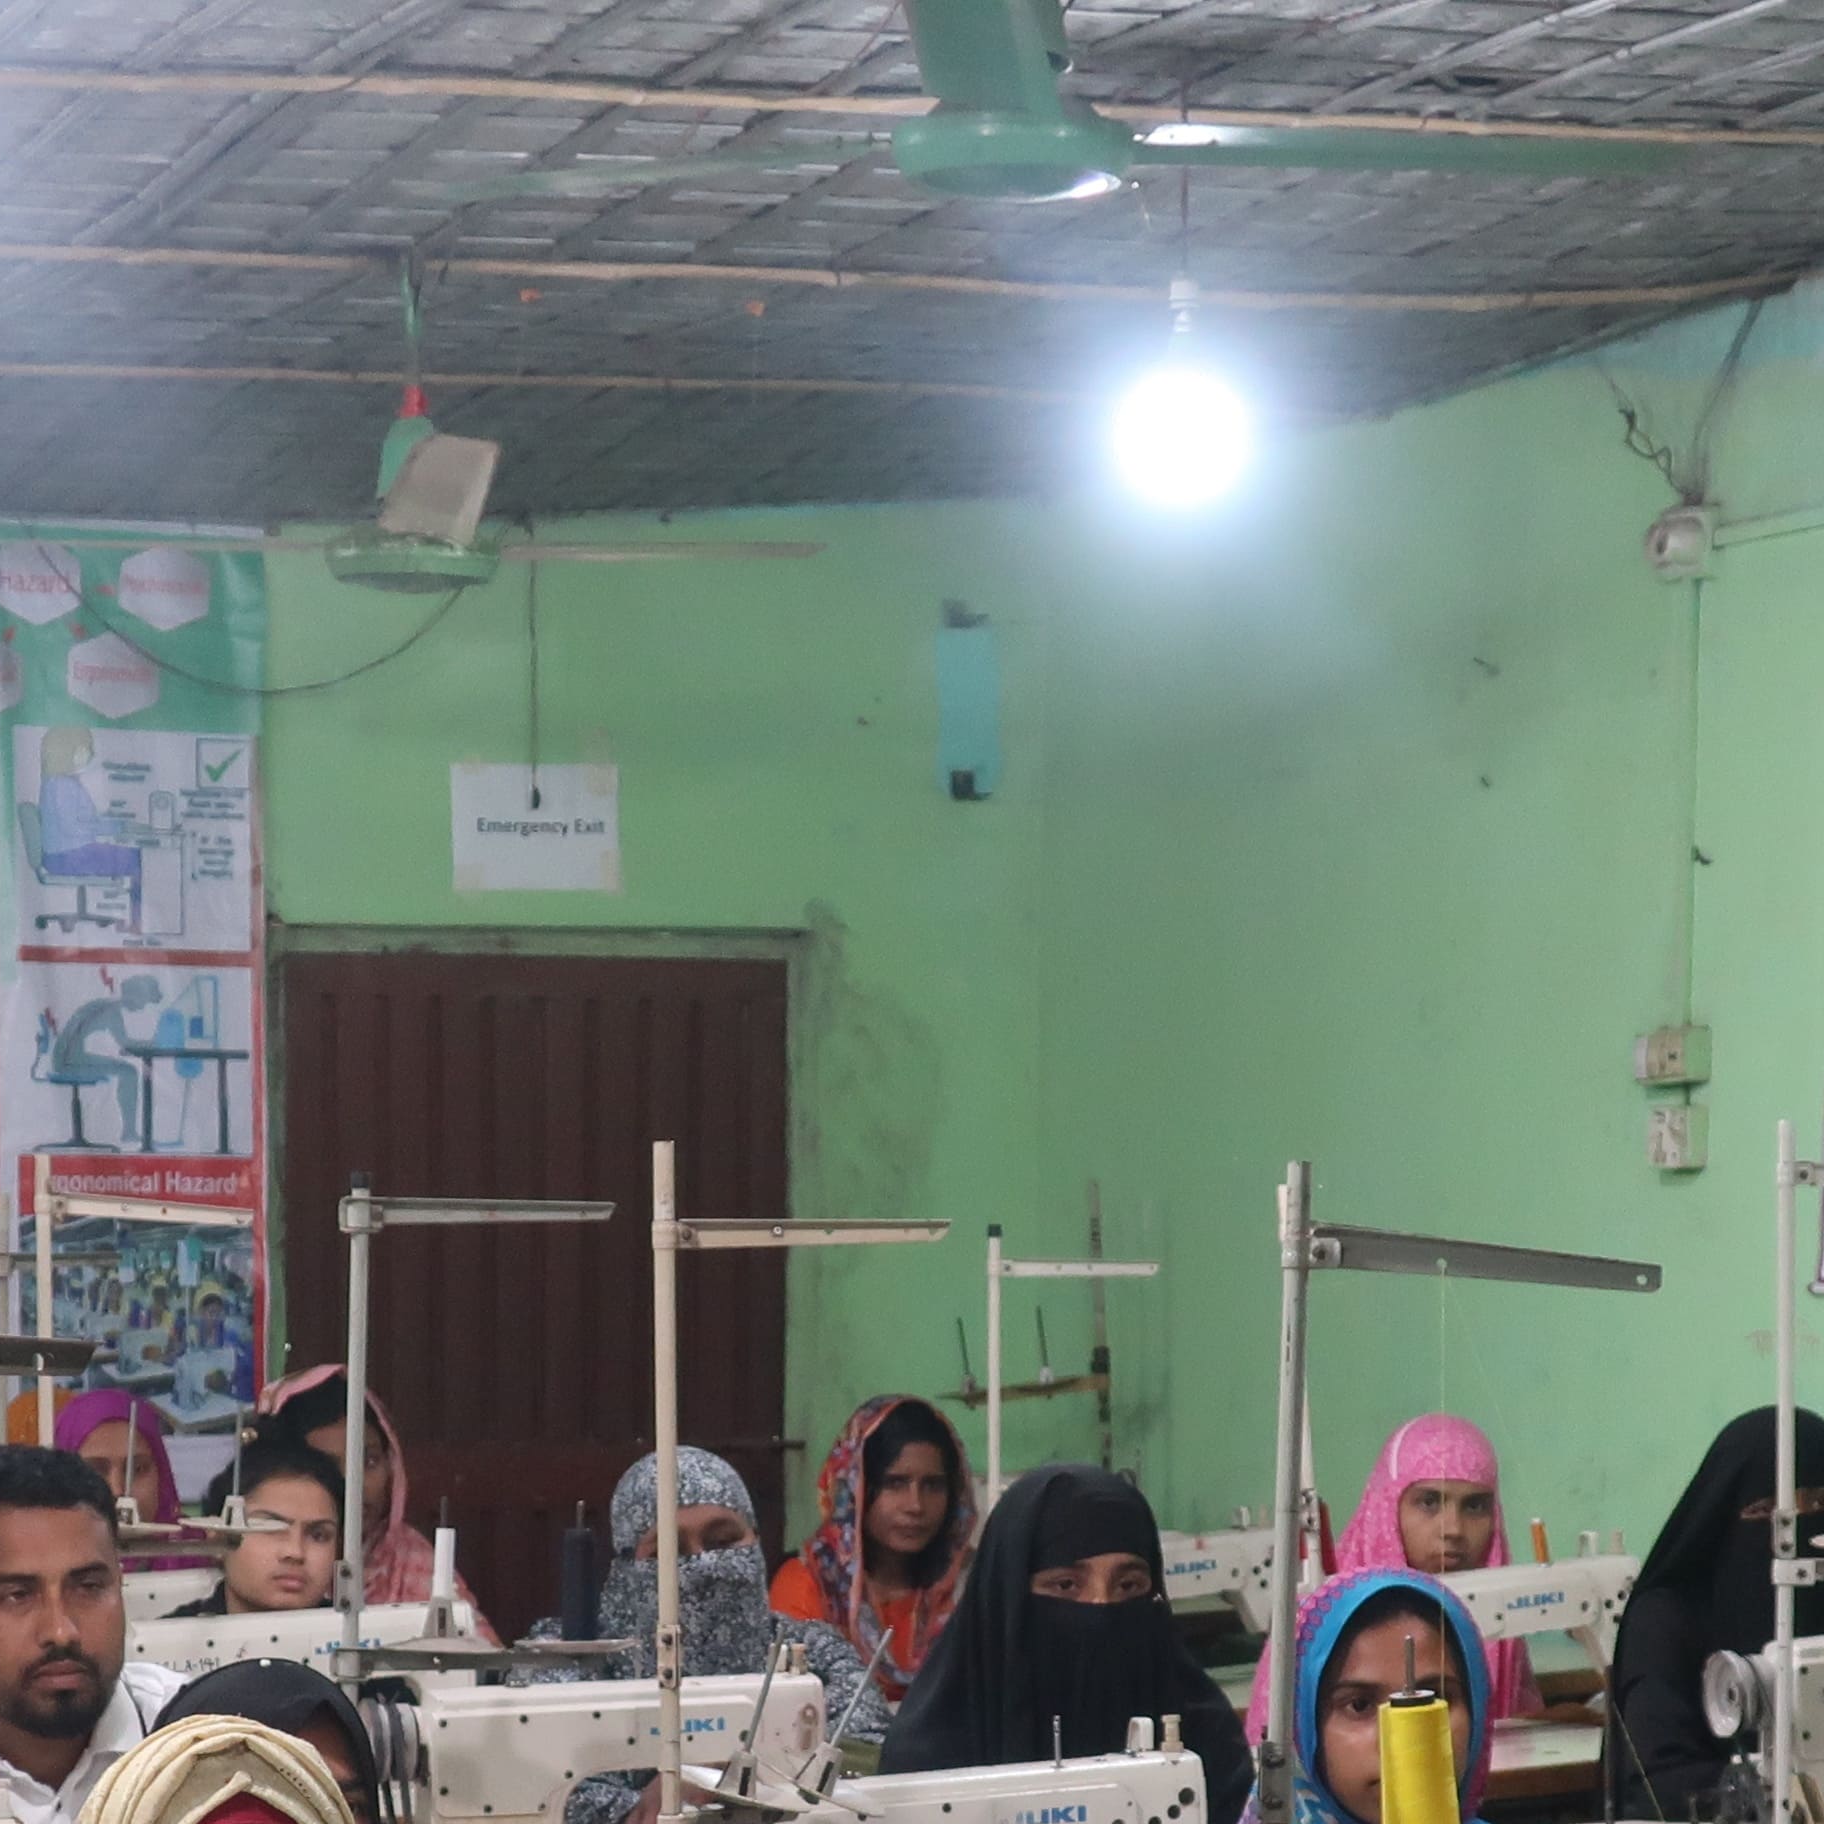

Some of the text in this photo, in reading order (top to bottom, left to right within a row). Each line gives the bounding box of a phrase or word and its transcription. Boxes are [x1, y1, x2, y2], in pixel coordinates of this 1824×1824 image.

[477, 817, 605, 836] Emergency Exit
[165, 1171, 237, 1194] Hazard
[1506, 1591, 1565, 1610] JUKI
